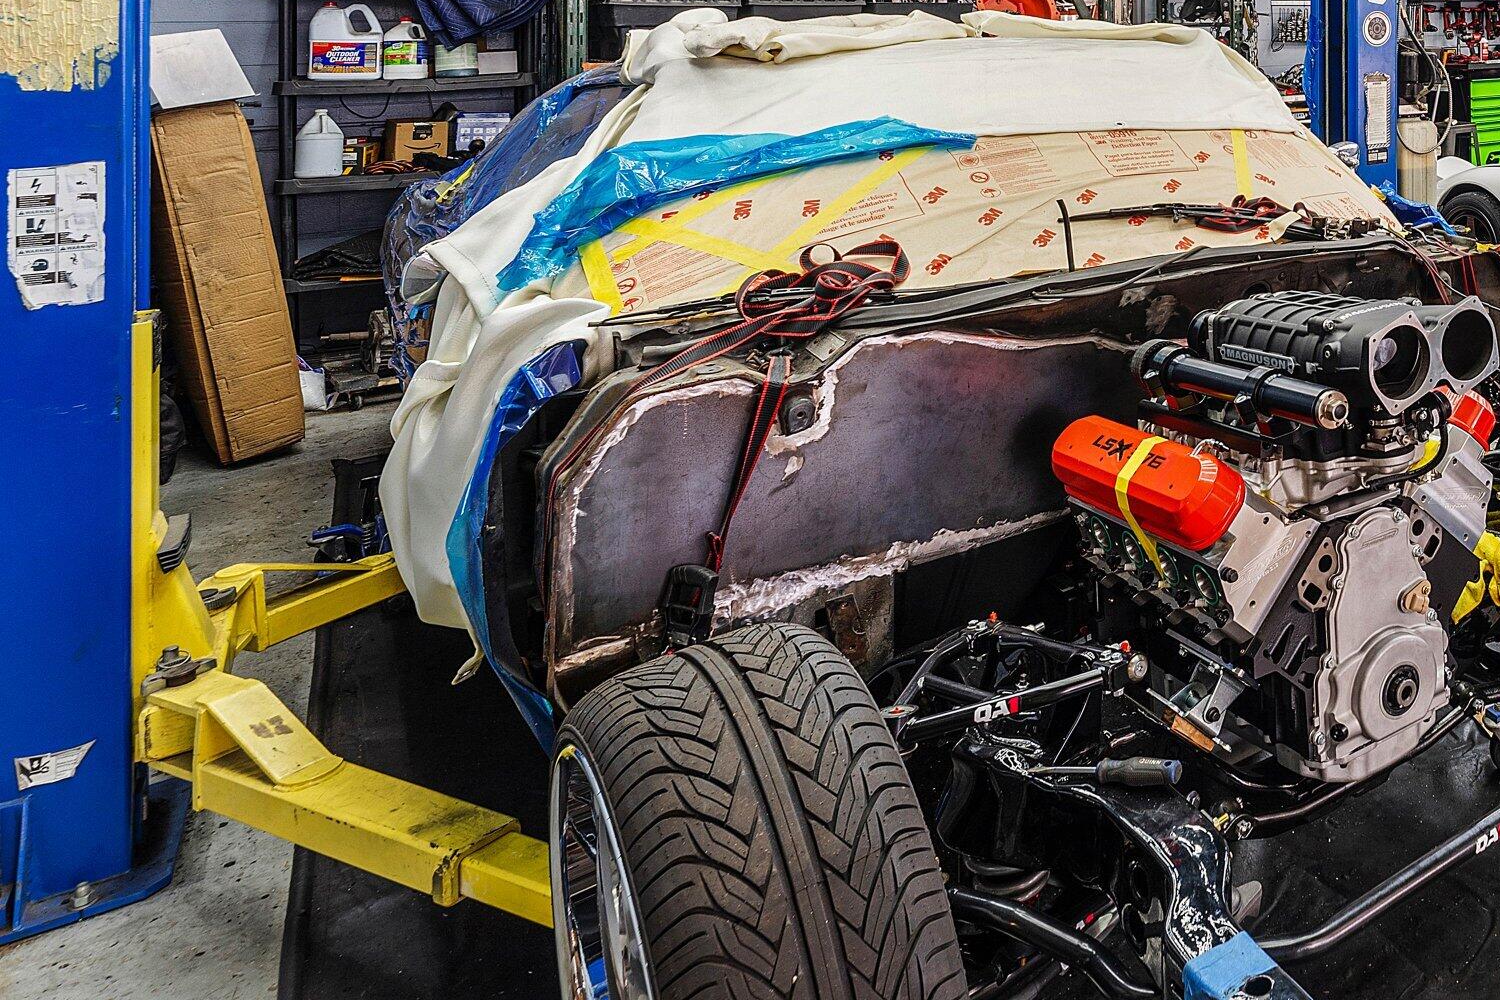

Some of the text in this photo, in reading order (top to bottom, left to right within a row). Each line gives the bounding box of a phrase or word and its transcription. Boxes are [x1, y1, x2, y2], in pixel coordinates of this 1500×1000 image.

[326, 49, 359, 57] OUTDOOR
[1194, 150, 1211, 164] 3M
[1163, 178, 1182, 194] 3M
[1254, 173, 1276, 186] 3M
[922, 186, 950, 205] 3M
[1076, 188, 1098, 205] 3M
[733, 199, 753, 221] 3M
[802, 199, 821, 218] 3M
[977, 207, 1004, 226] 3M
[856, 213, 886, 224] soudage
[1032, 228, 1057, 248] 3M
[1175, 236, 1195, 252] 3M
[925, 253, 953, 276] 3M
[1226, 349, 1288, 371] MAGNUSON
[1092, 435, 1167, 469] LSX 76
[974, 697, 1019, 723] QA1
